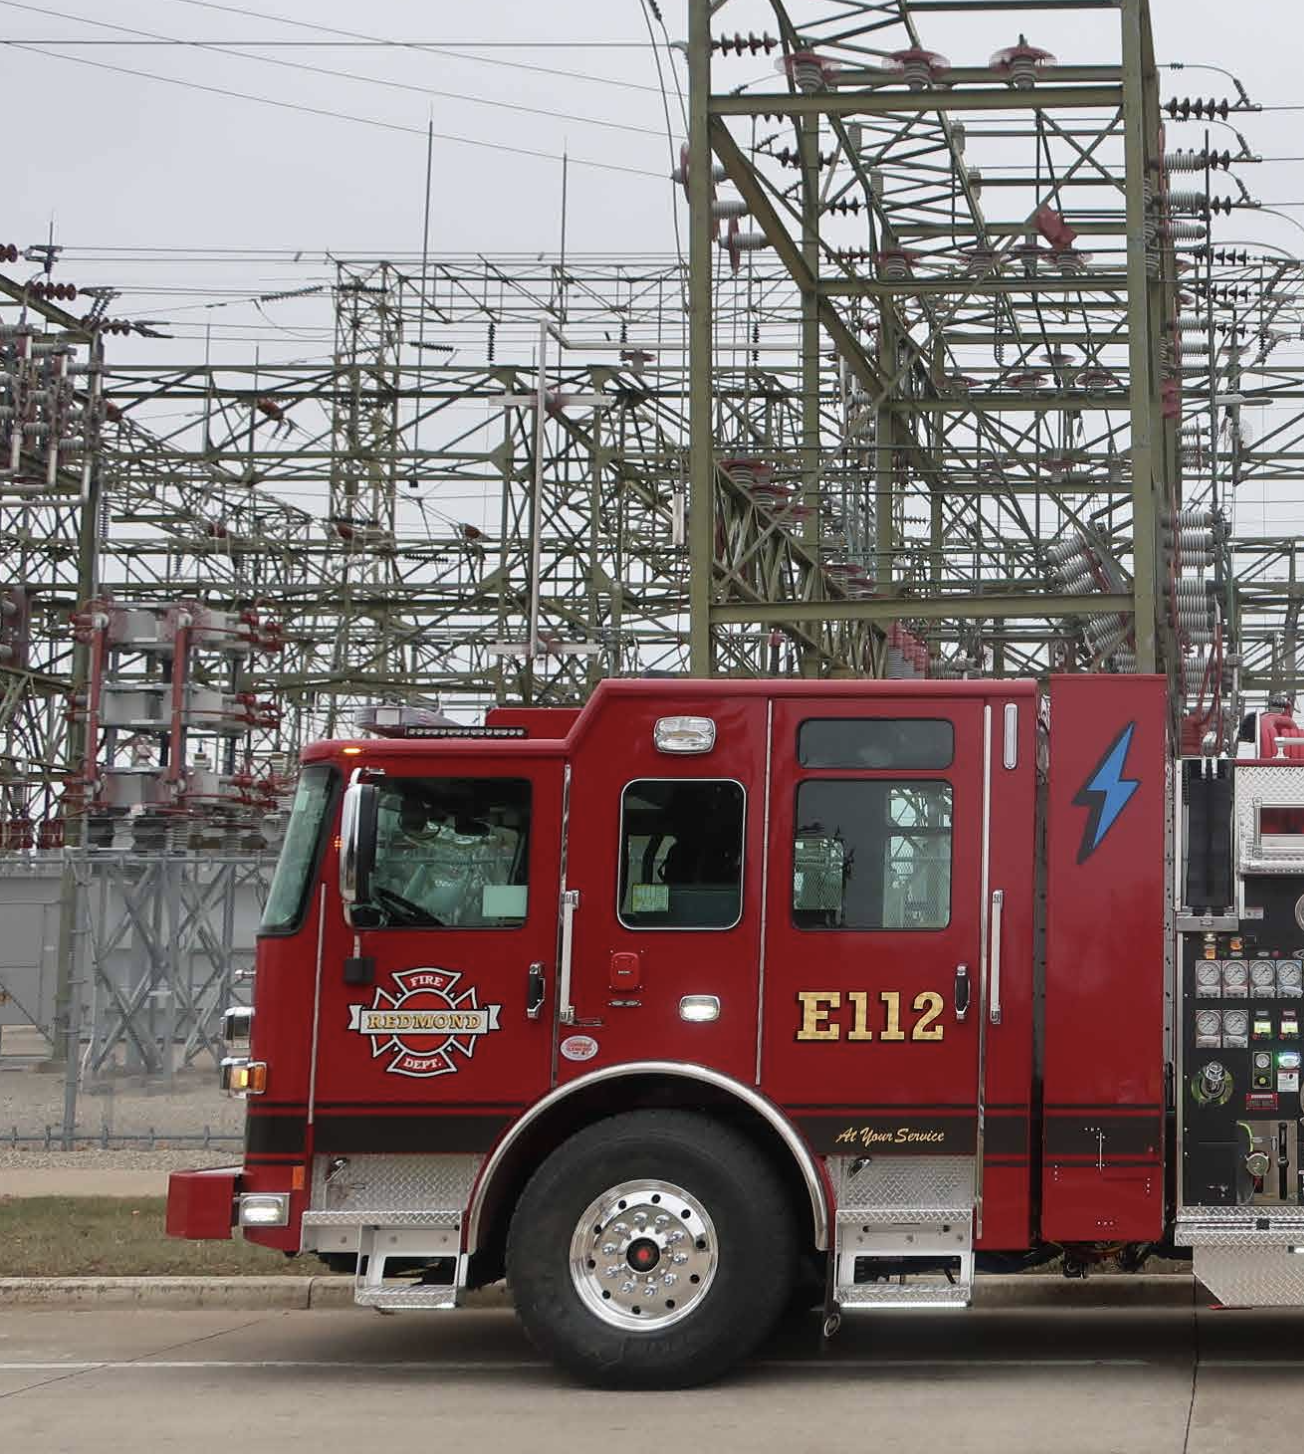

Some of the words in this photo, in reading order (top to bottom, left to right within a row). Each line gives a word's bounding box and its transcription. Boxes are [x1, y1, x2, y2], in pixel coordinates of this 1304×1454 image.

[410, 975, 443, 987] FIRE
[367, 1014, 482, 1030] REDMOND
[795, 991, 944, 1041] E112
[403, 1058, 442, 1070] DEPT.
[836, 1127, 857, 1143] At
[860, 1127, 893, 1147] Your
[895, 1128, 944, 1144] Service
